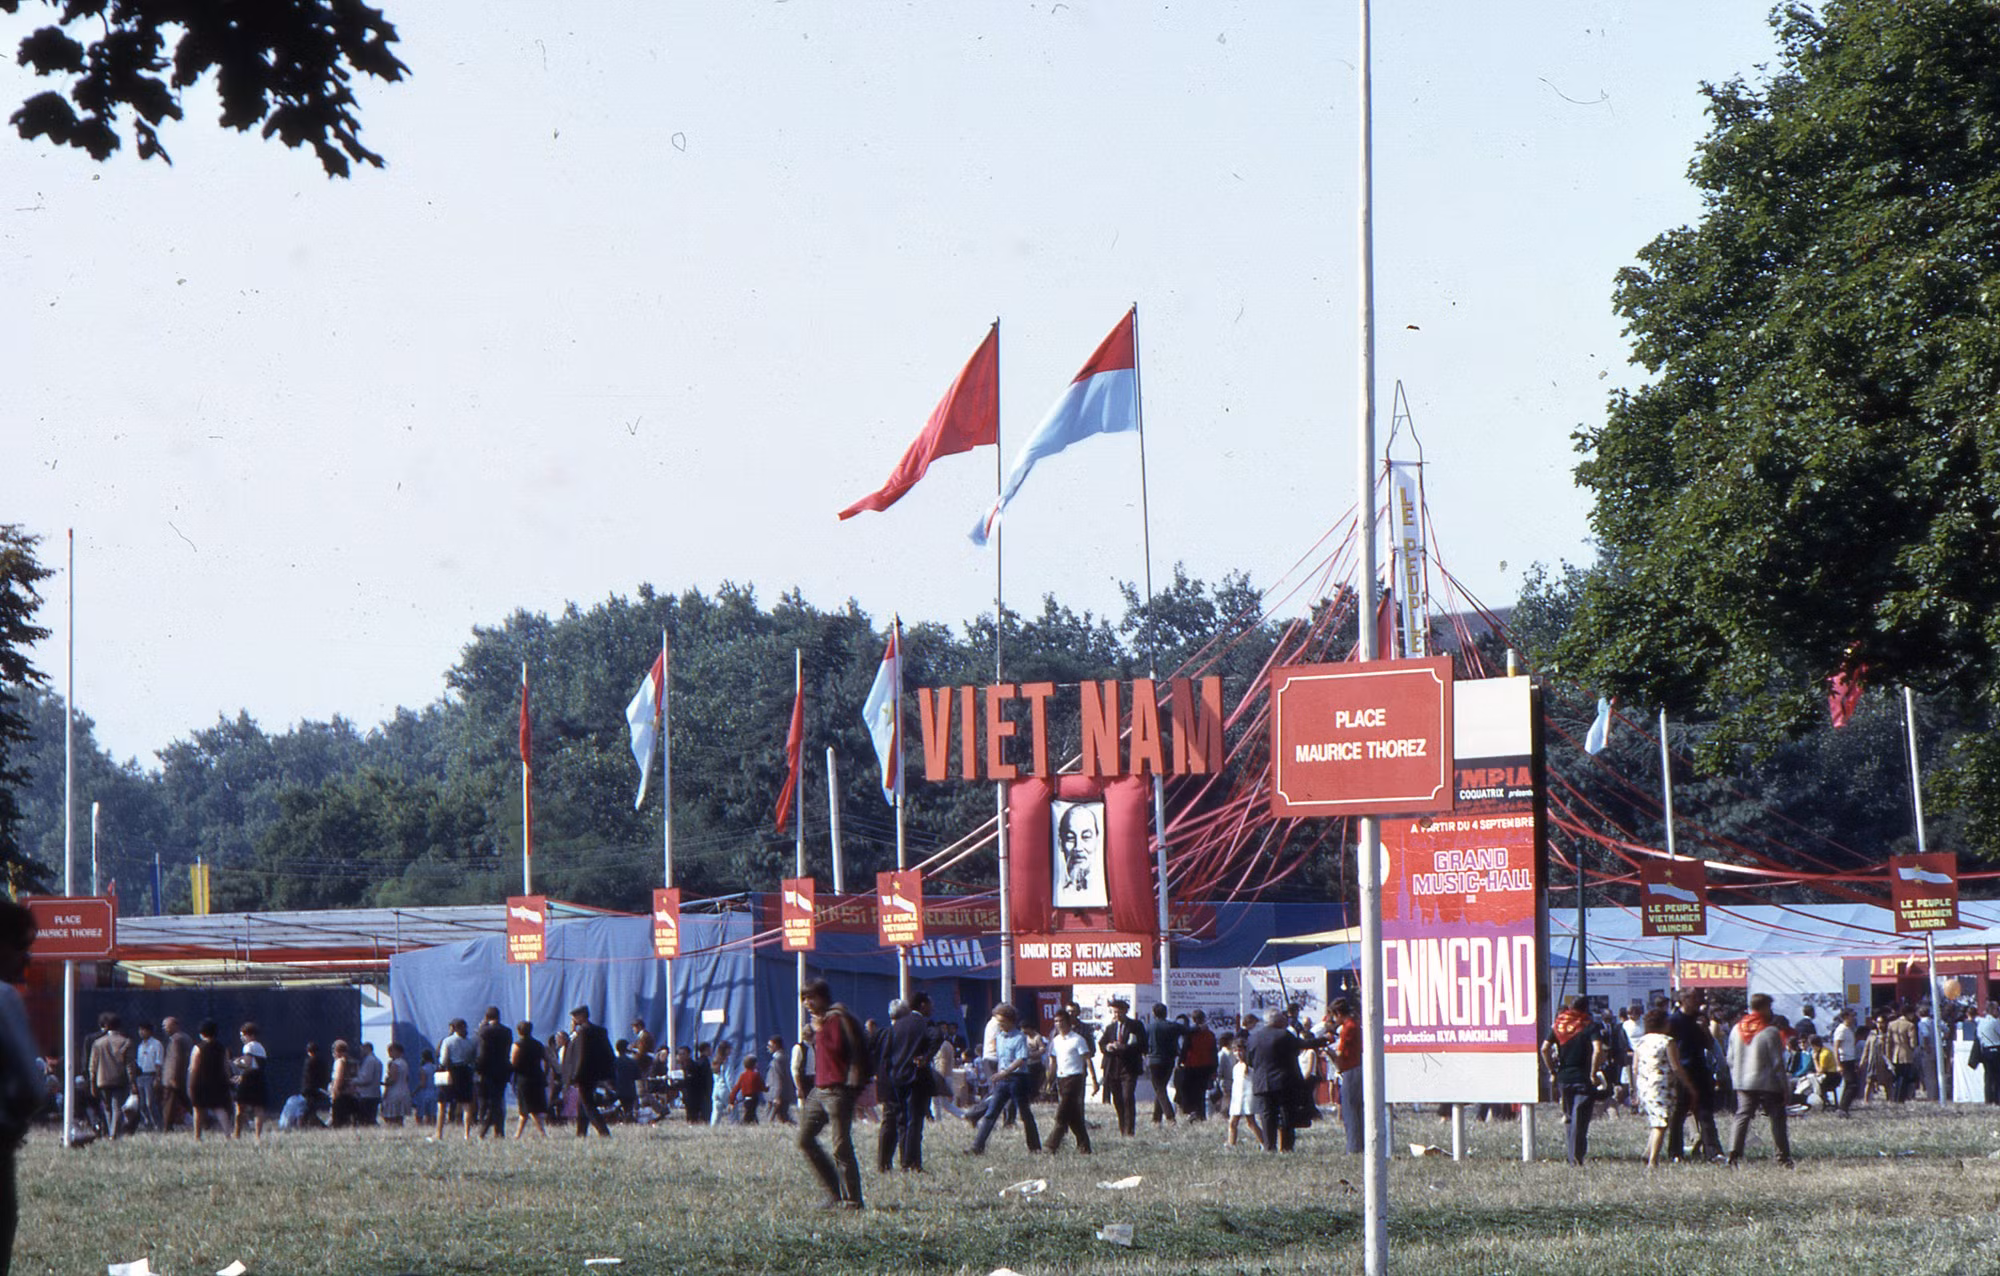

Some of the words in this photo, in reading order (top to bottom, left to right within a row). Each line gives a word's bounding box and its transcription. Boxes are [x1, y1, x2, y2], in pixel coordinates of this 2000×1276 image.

[1400, 487, 1413, 526] LE
[1404, 538, 1421, 652] PEUPLE
[1335, 708, 1386, 728] PLACE
[918, 681, 1056, 781] VIET
[1080, 676, 1226, 777] NAM
[1295, 742, 1362, 763] MAURICE
[1366, 738, 1427, 759] THOREZ
[1459, 788, 1505, 800] COQUATRIX
[1457, 819, 1470, 832] DU
[1471, 819, 1479, 831] 4
[1480, 816, 1535, 830] SEPTEMBRE
[1433, 847, 1509, 872] GRAND
[1412, 868, 1533, 896] MUSIC-HALL
[1648, 903, 1661, 913] LE
[1665, 903, 1700, 913] PEUPLE
[1900, 899, 1913, 909] LE
[1917, 898, 1952, 908] PEUPLE
[54, 915, 82, 925] PLACE
[1909, 918, 1947, 928] VAINCRA
[70, 927, 103, 938] THOREZ
[1656, 924, 1695, 933] VAINCRA
[1019, 943, 1049, 959] UNION
[1050, 943, 1072, 959] DES
[1075, 942, 1142, 959] VIETNAMIENS
[1051, 961, 1067, 977] EN
[1072, 961, 1114, 977] FRANCE
[1169, 971, 1221, 980] VOLUTIONNAIRE
[1679, 961, 1747, 979] EVOLU
[1382, 935, 1537, 1027] ENINGRAD
[1392, 1029, 1436, 1045] production
[1436, 1029, 1457, 1043] ILYA
